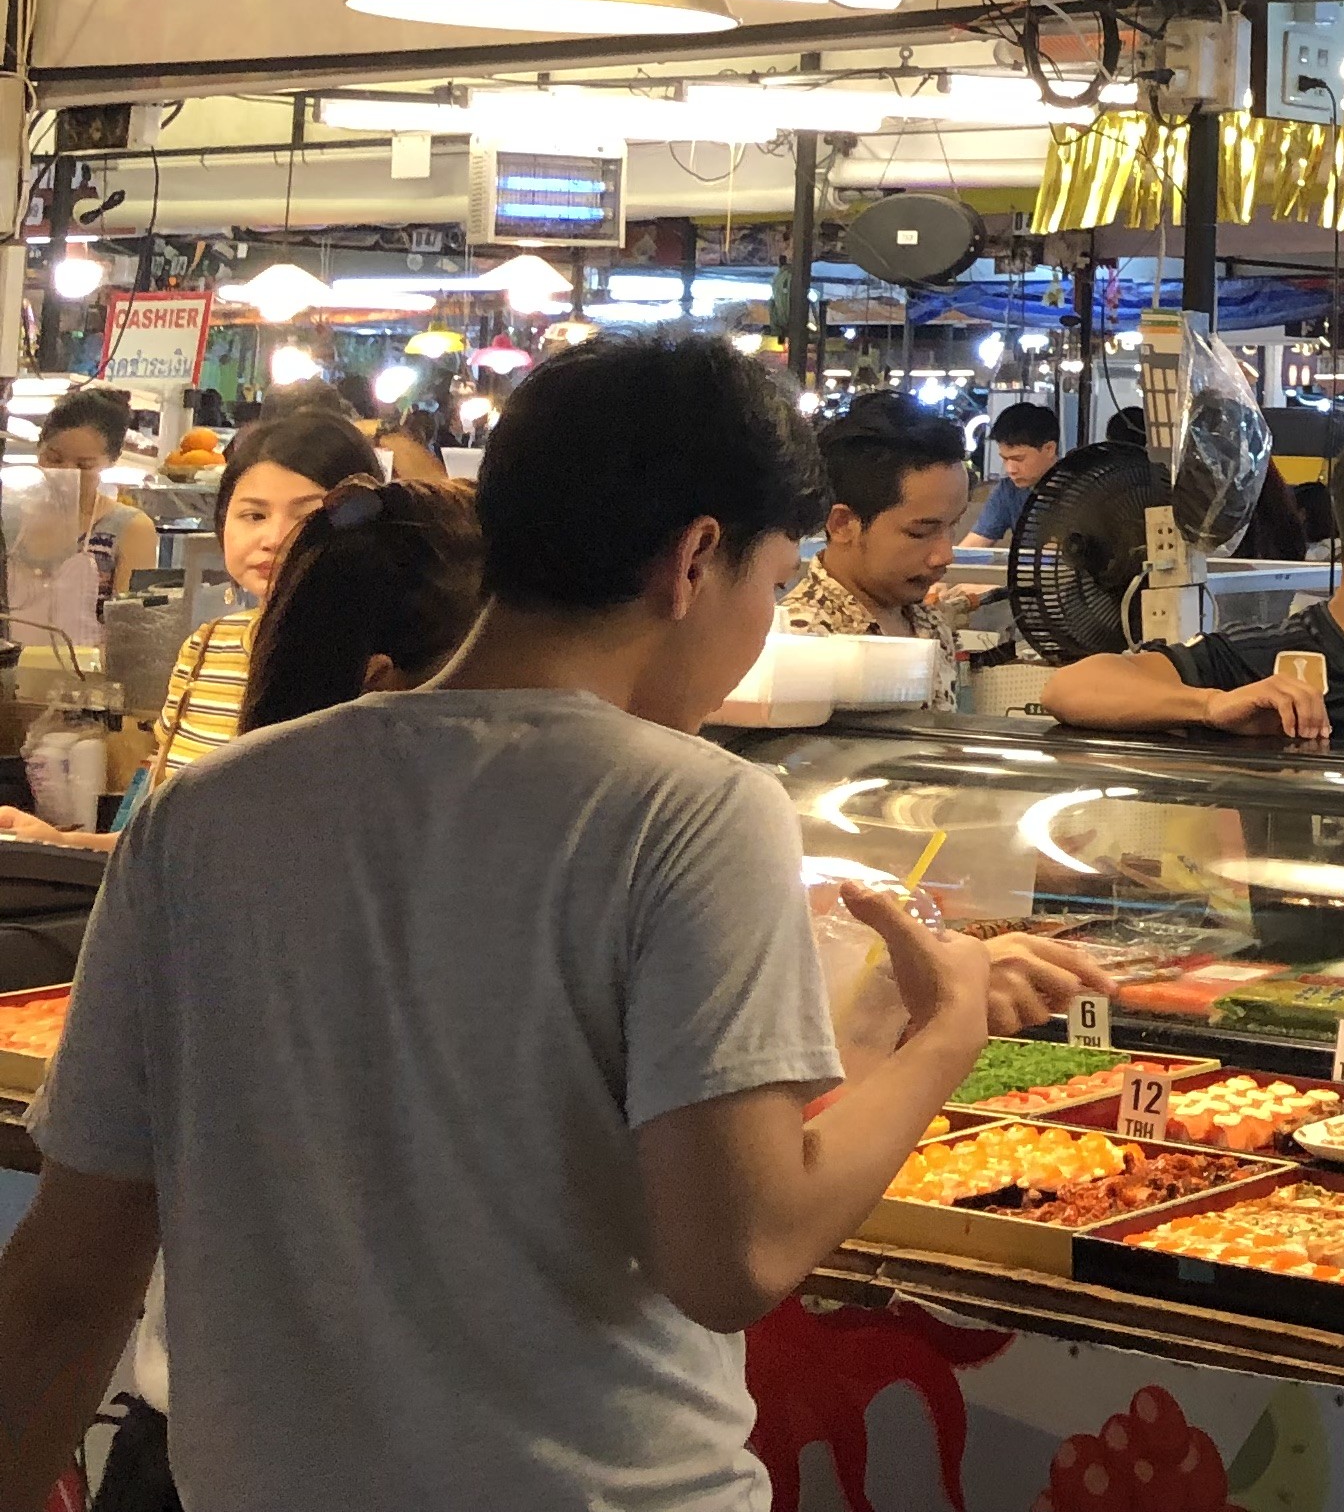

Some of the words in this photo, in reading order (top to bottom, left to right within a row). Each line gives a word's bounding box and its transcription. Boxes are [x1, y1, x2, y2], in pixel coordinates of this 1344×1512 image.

[115, 308, 199, 329] CASHIER
[1081, 1000, 1096, 1029] 6
[1131, 1078, 1164, 1115] 12
